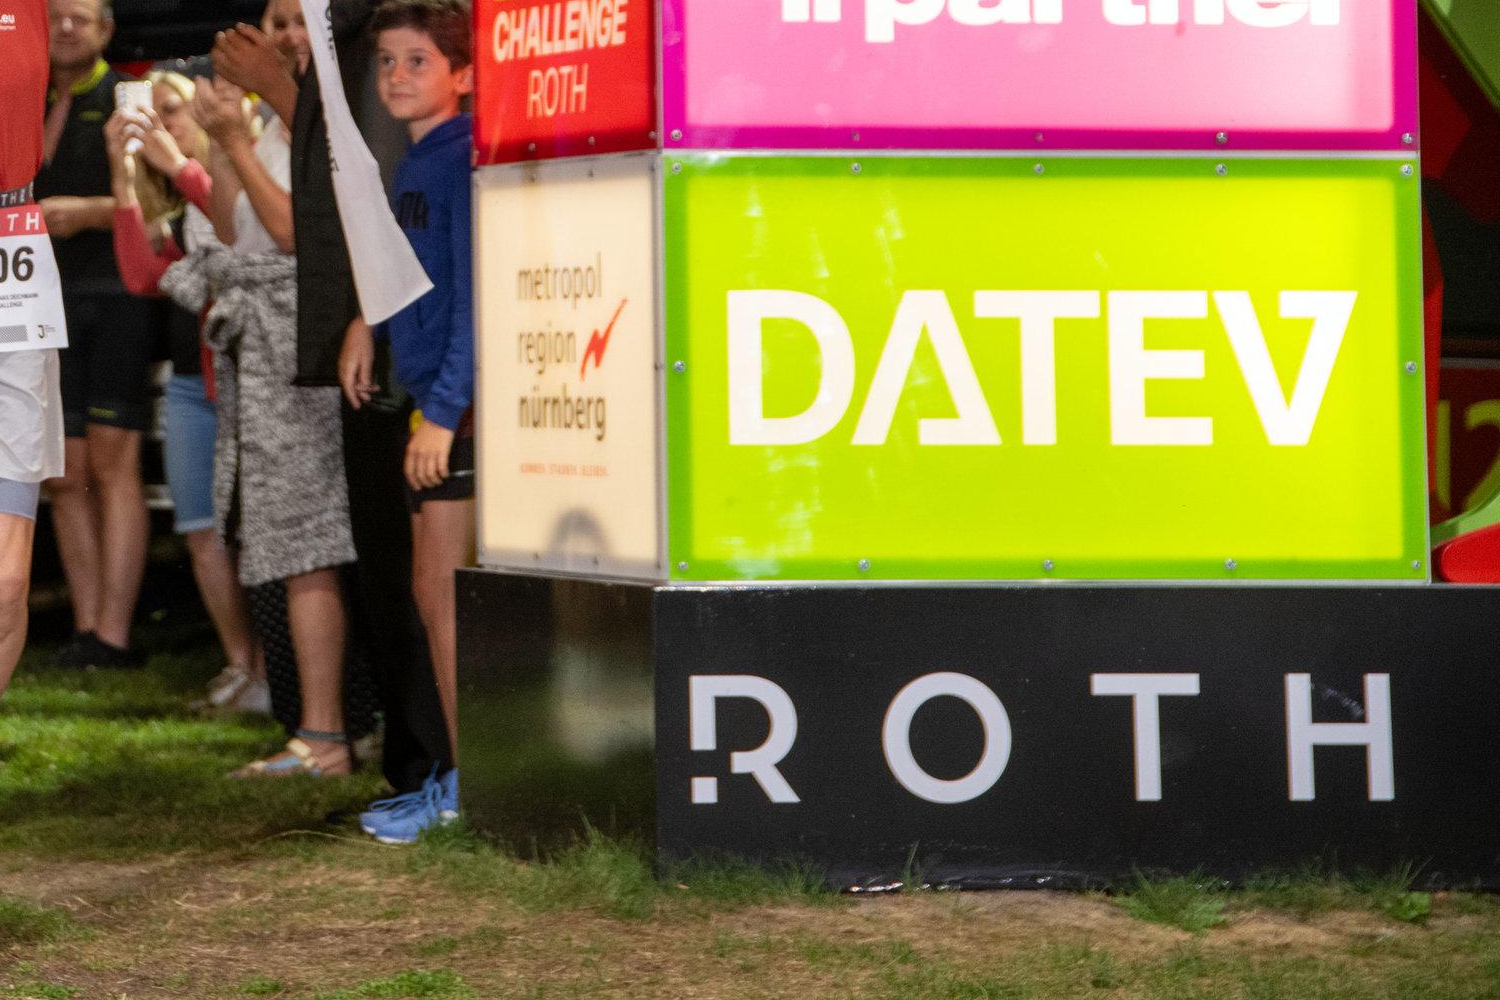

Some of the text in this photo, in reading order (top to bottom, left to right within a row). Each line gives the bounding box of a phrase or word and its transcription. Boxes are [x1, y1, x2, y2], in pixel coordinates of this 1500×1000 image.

[527, 63, 588, 119] ROTH
[517, 252, 602, 309] metropol
[517, 321, 576, 374] region
[726, 289, 1358, 446] DATEV
[518, 384, 606, 441] nürnberg
[690, 671, 1394, 803] ROTH
